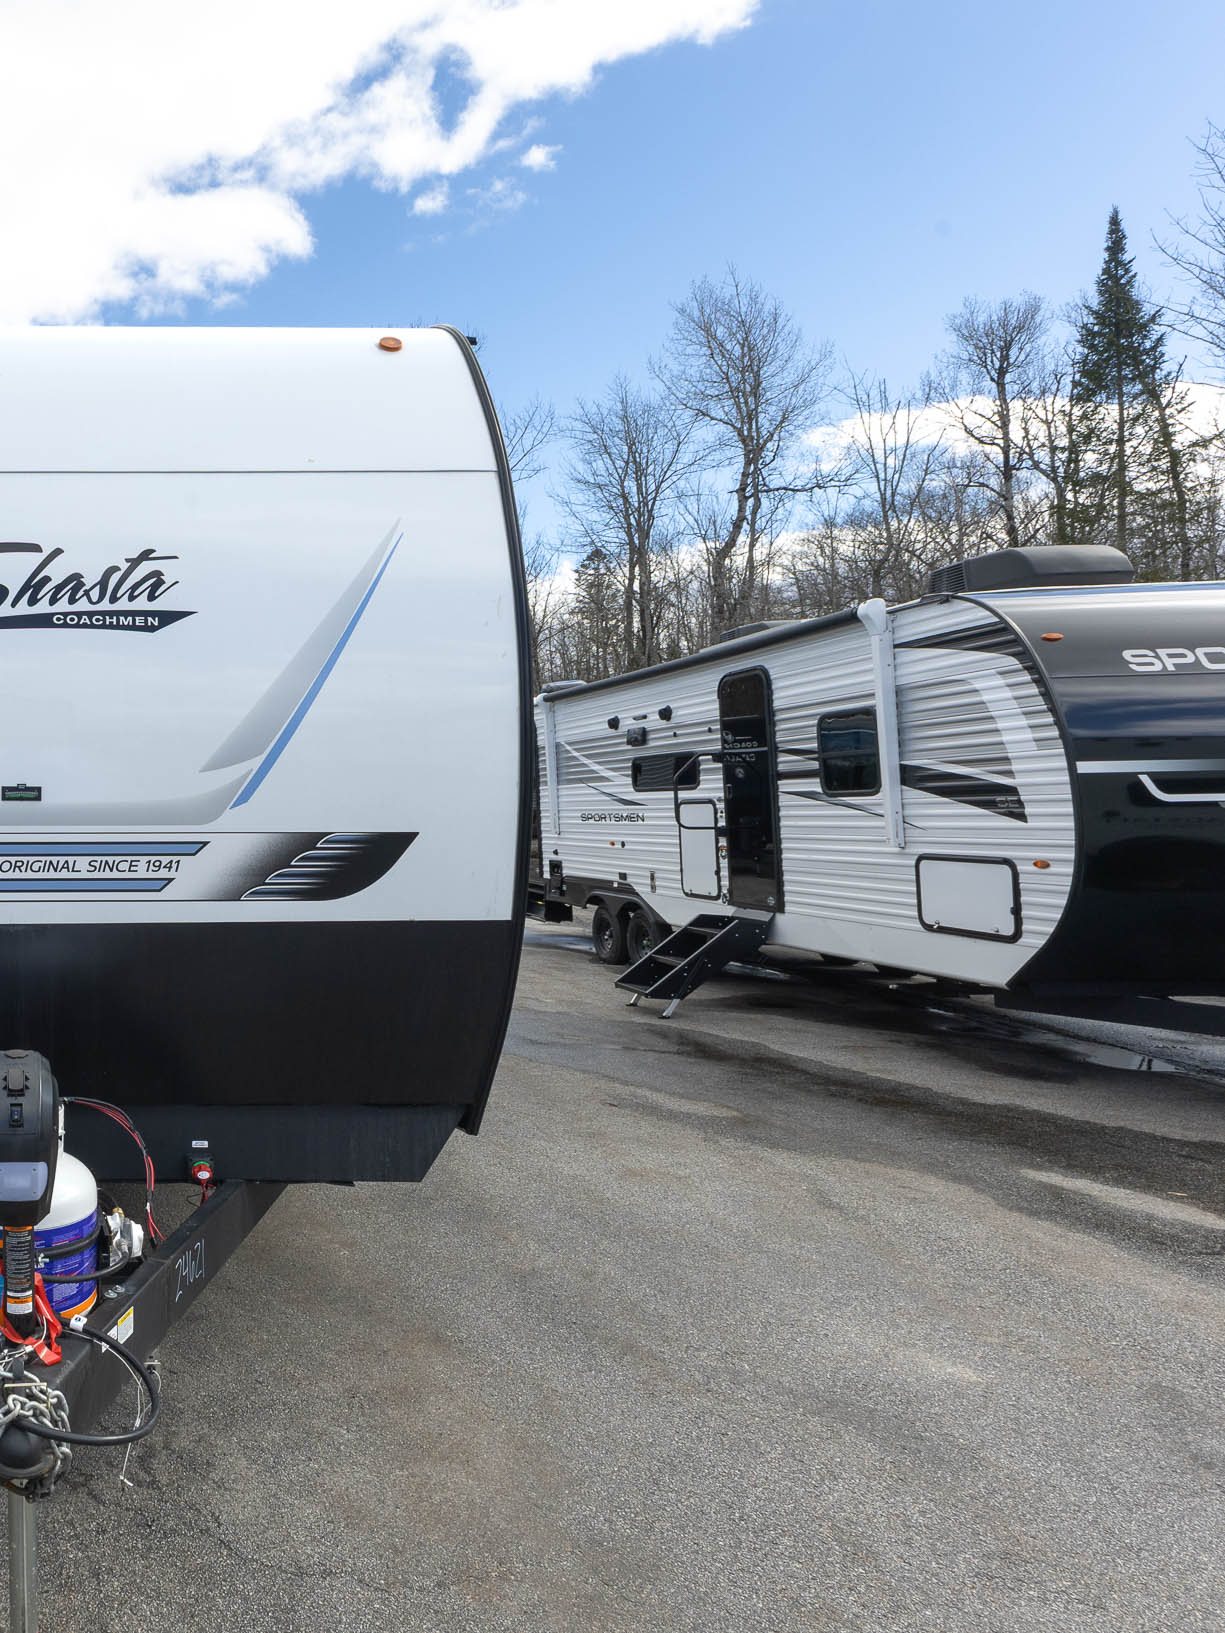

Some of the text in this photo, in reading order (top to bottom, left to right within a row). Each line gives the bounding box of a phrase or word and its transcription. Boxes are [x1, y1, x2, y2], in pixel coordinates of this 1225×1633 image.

[52, 614, 160, 627] COACHMEN
[580, 812, 646, 823] SPORTSMEN
[86, 860, 140, 873] SINCE
[144, 859, 181, 873] 1941
